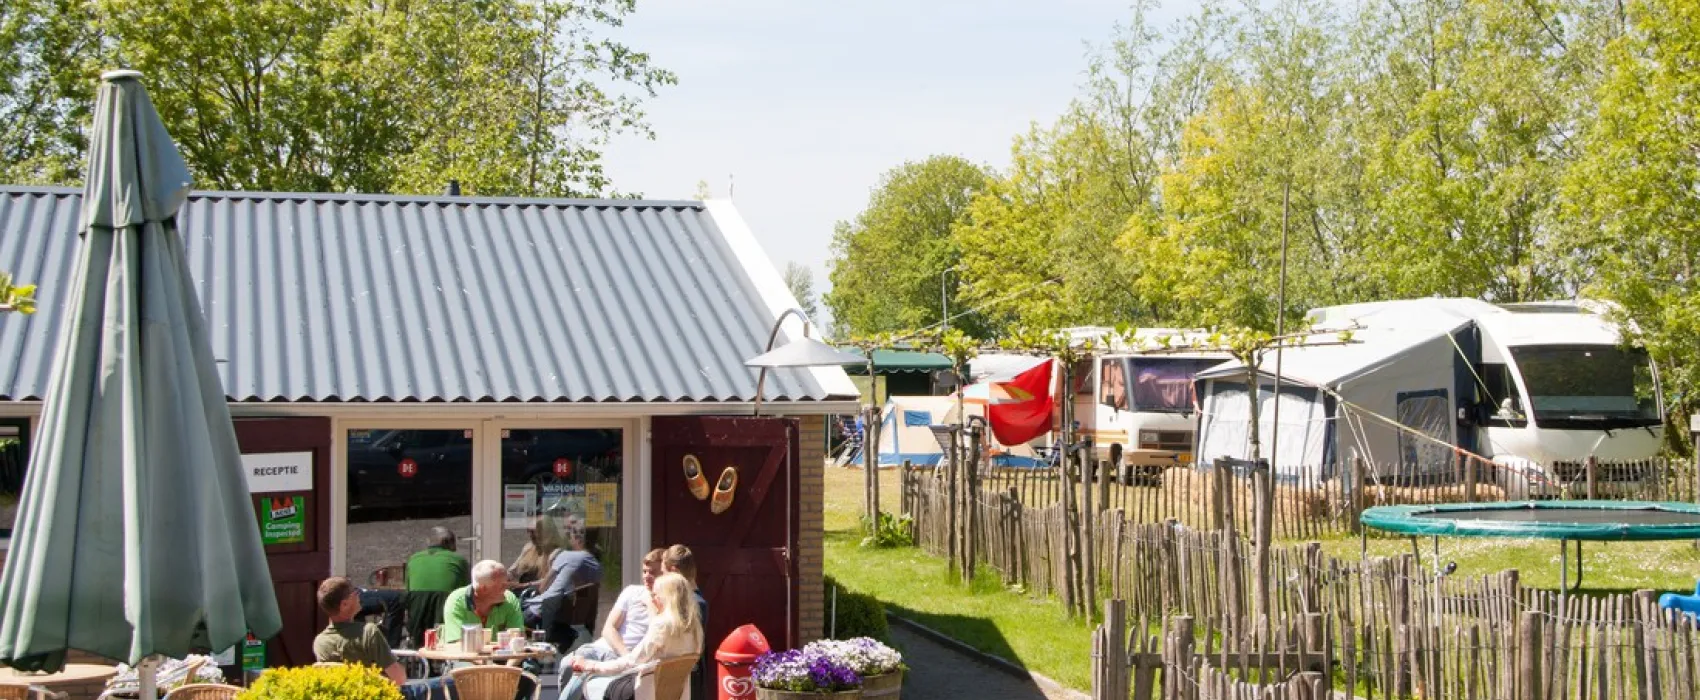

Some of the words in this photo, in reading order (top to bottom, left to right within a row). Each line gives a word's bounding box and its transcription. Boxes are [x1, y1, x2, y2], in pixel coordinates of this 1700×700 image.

[253, 466, 299, 475] RECEPTIE
[402, 463, 414, 473] DE
[265, 522, 301, 530] Camping
[265, 530, 301, 538] Inspected
